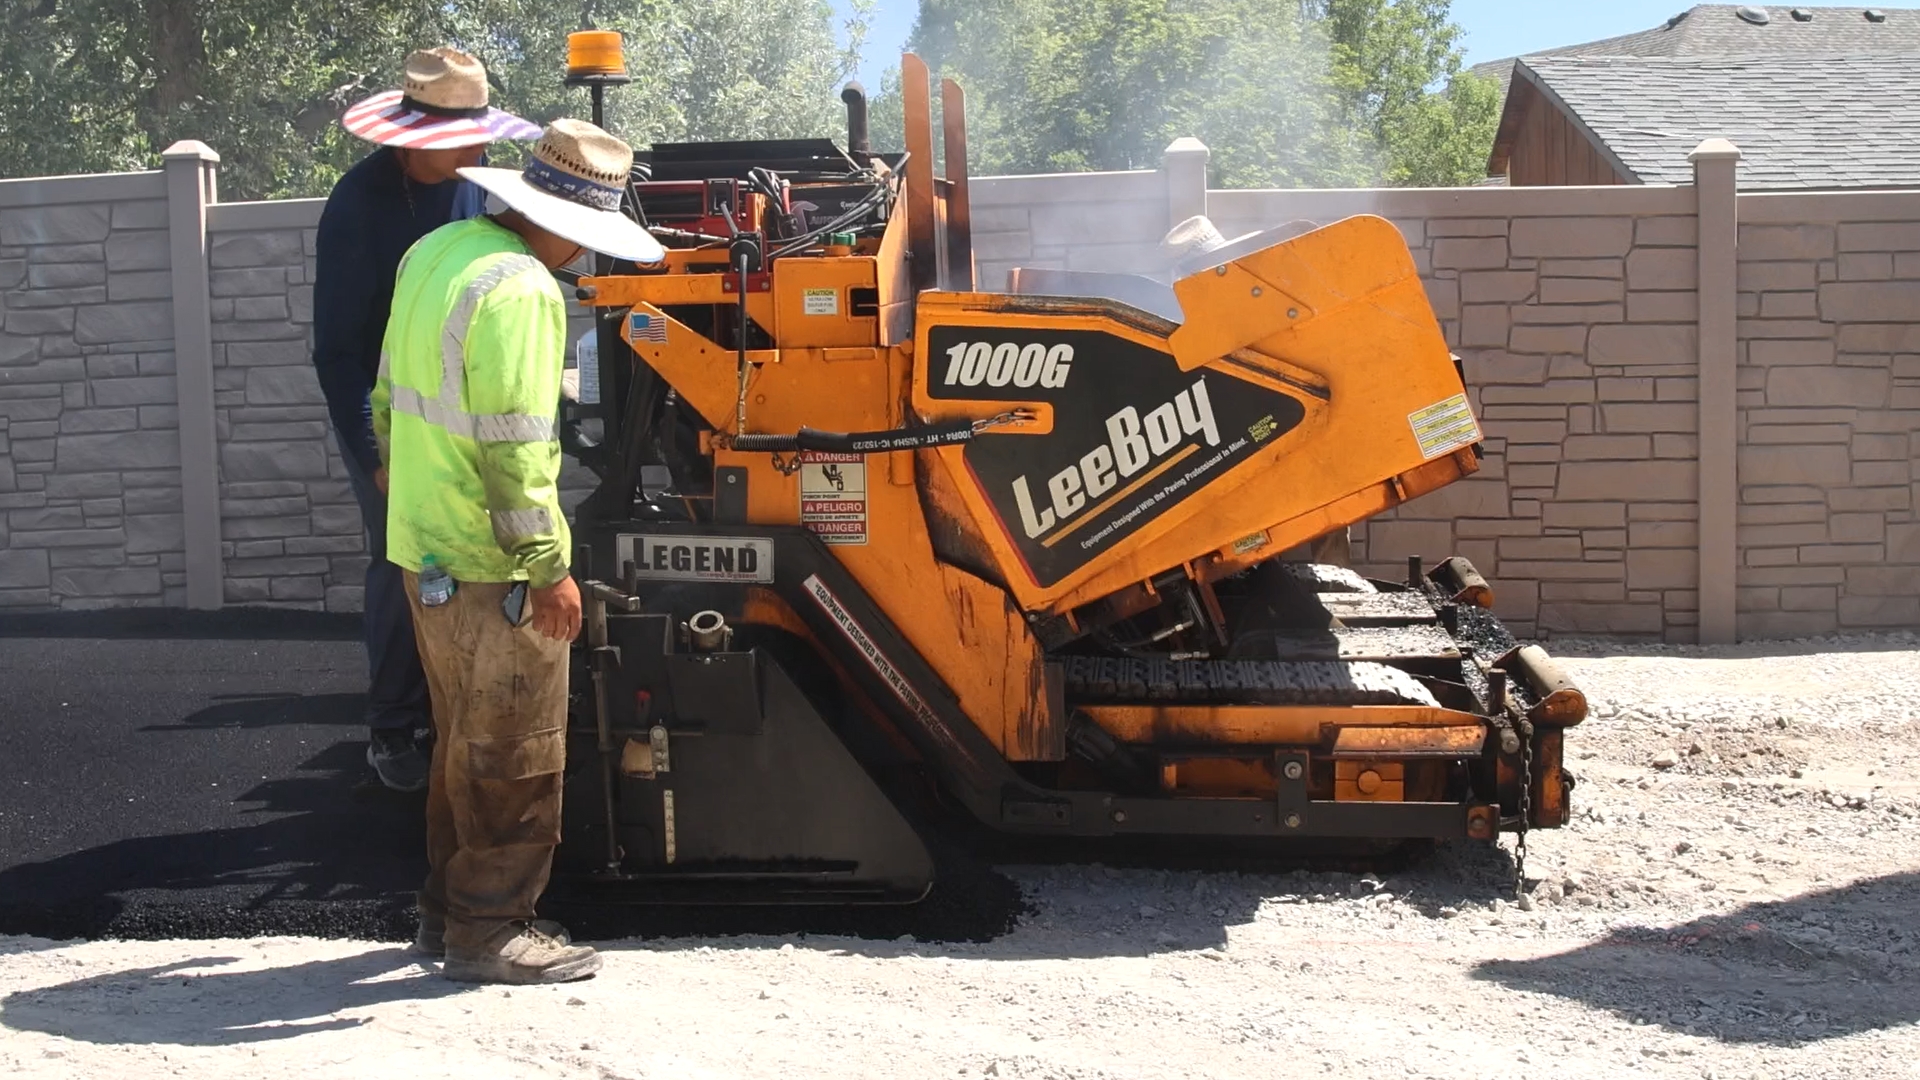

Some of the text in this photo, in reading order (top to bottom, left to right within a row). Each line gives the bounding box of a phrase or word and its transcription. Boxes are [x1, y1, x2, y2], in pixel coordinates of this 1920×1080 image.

[943, 341, 1075, 388] 1000G
[1248, 414, 1273, 433] CAUTION
[926, 433, 939, 443] HT
[815, 453, 861, 462] DANGER
[1012, 378, 1221, 540] LeeBoy
[816, 503, 862, 512] PELIGRO
[1080, 525, 1114, 549] Equipment
[1111, 506, 1141, 530] Designed
[1139, 498, 1156, 511] With
[1153, 491, 1166, 502] the
[1163, 478, 1187, 495] Paving
[1184, 453, 1223, 481] Professional
[818, 523, 862, 532] DANGER
[633, 537, 758, 573] LEGEND
[847, 622, 876, 658] DESIGNED
[873, 652, 889, 676] WITH
[888, 669, 901, 687] THE
